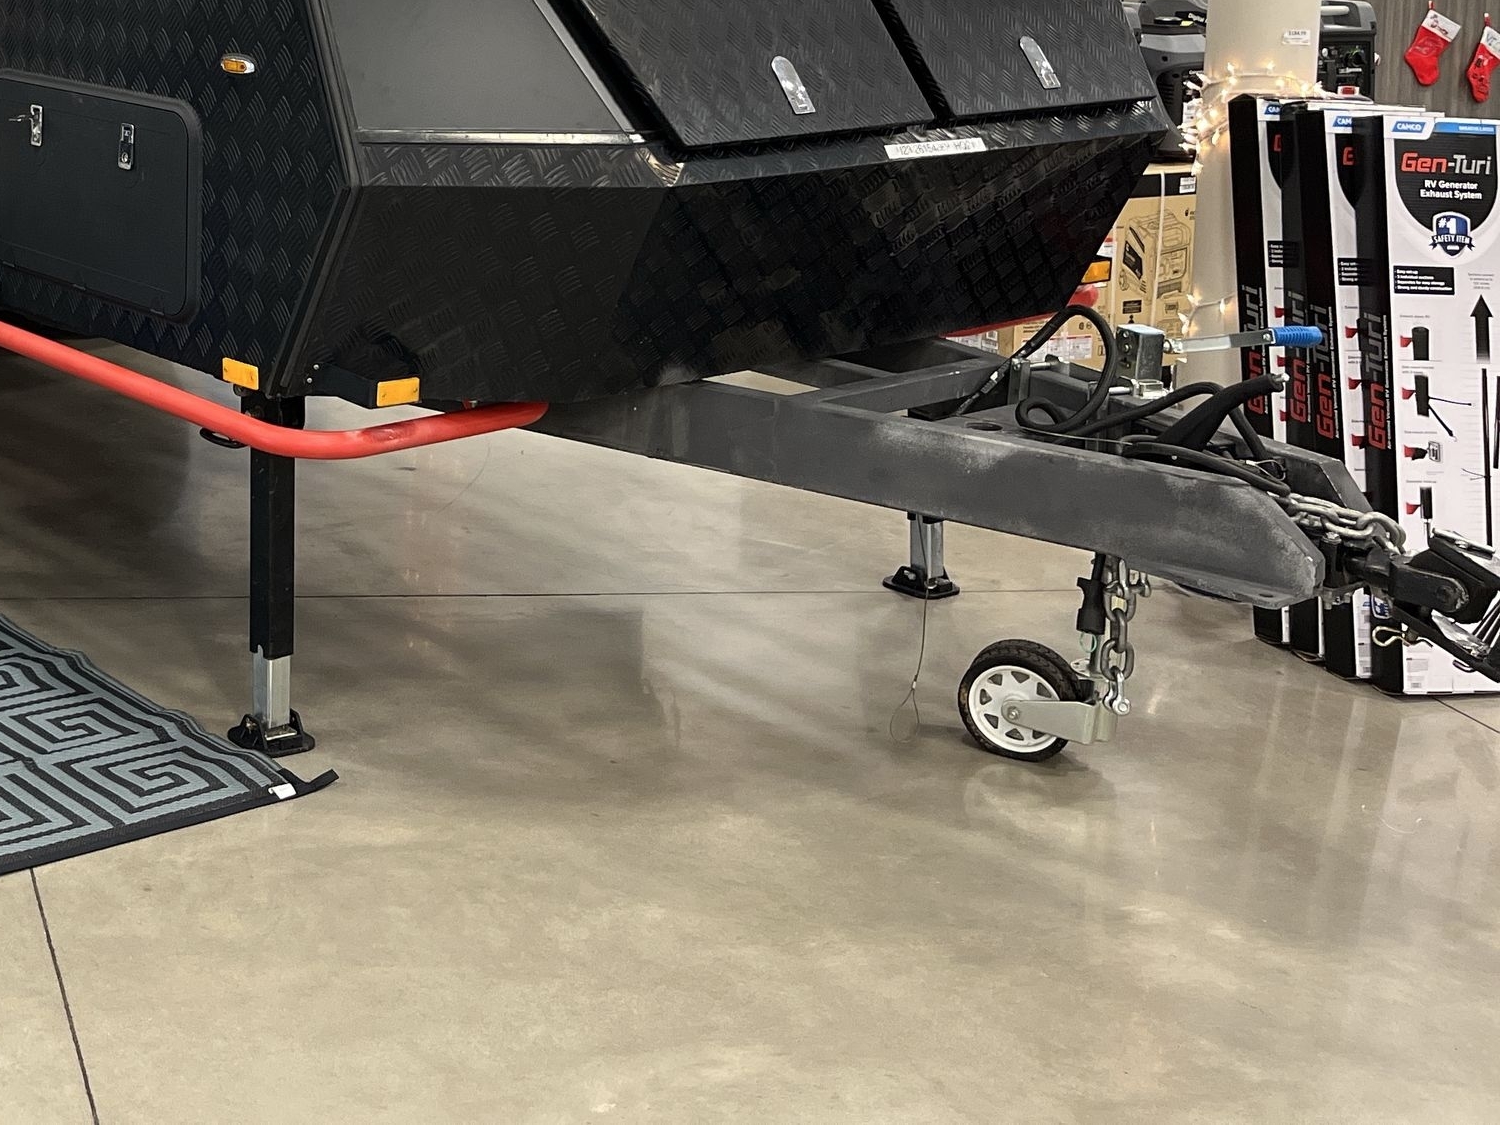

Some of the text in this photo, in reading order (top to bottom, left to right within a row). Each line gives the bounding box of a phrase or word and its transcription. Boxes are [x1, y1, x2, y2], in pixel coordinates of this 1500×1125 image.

[1396, 122, 1422, 131] CAMCO
[1401, 152, 1492, 175] Gen-Turi
[1424, 179, 1478, 190] RV Generator
[1420, 189, 1483, 200] Exhaust System
[1438, 217, 1457, 235] #1
[1433, 235, 1470, 244] SAFETY ITEM
[1242, 285, 1262, 415] Gn-uri
[1288, 290, 1306, 423] Gen-ri
[1332, 379, 1337, 389] RV
[1364, 312, 1386, 450] Gen-Turi
[1384, 389, 1390, 398] RV
